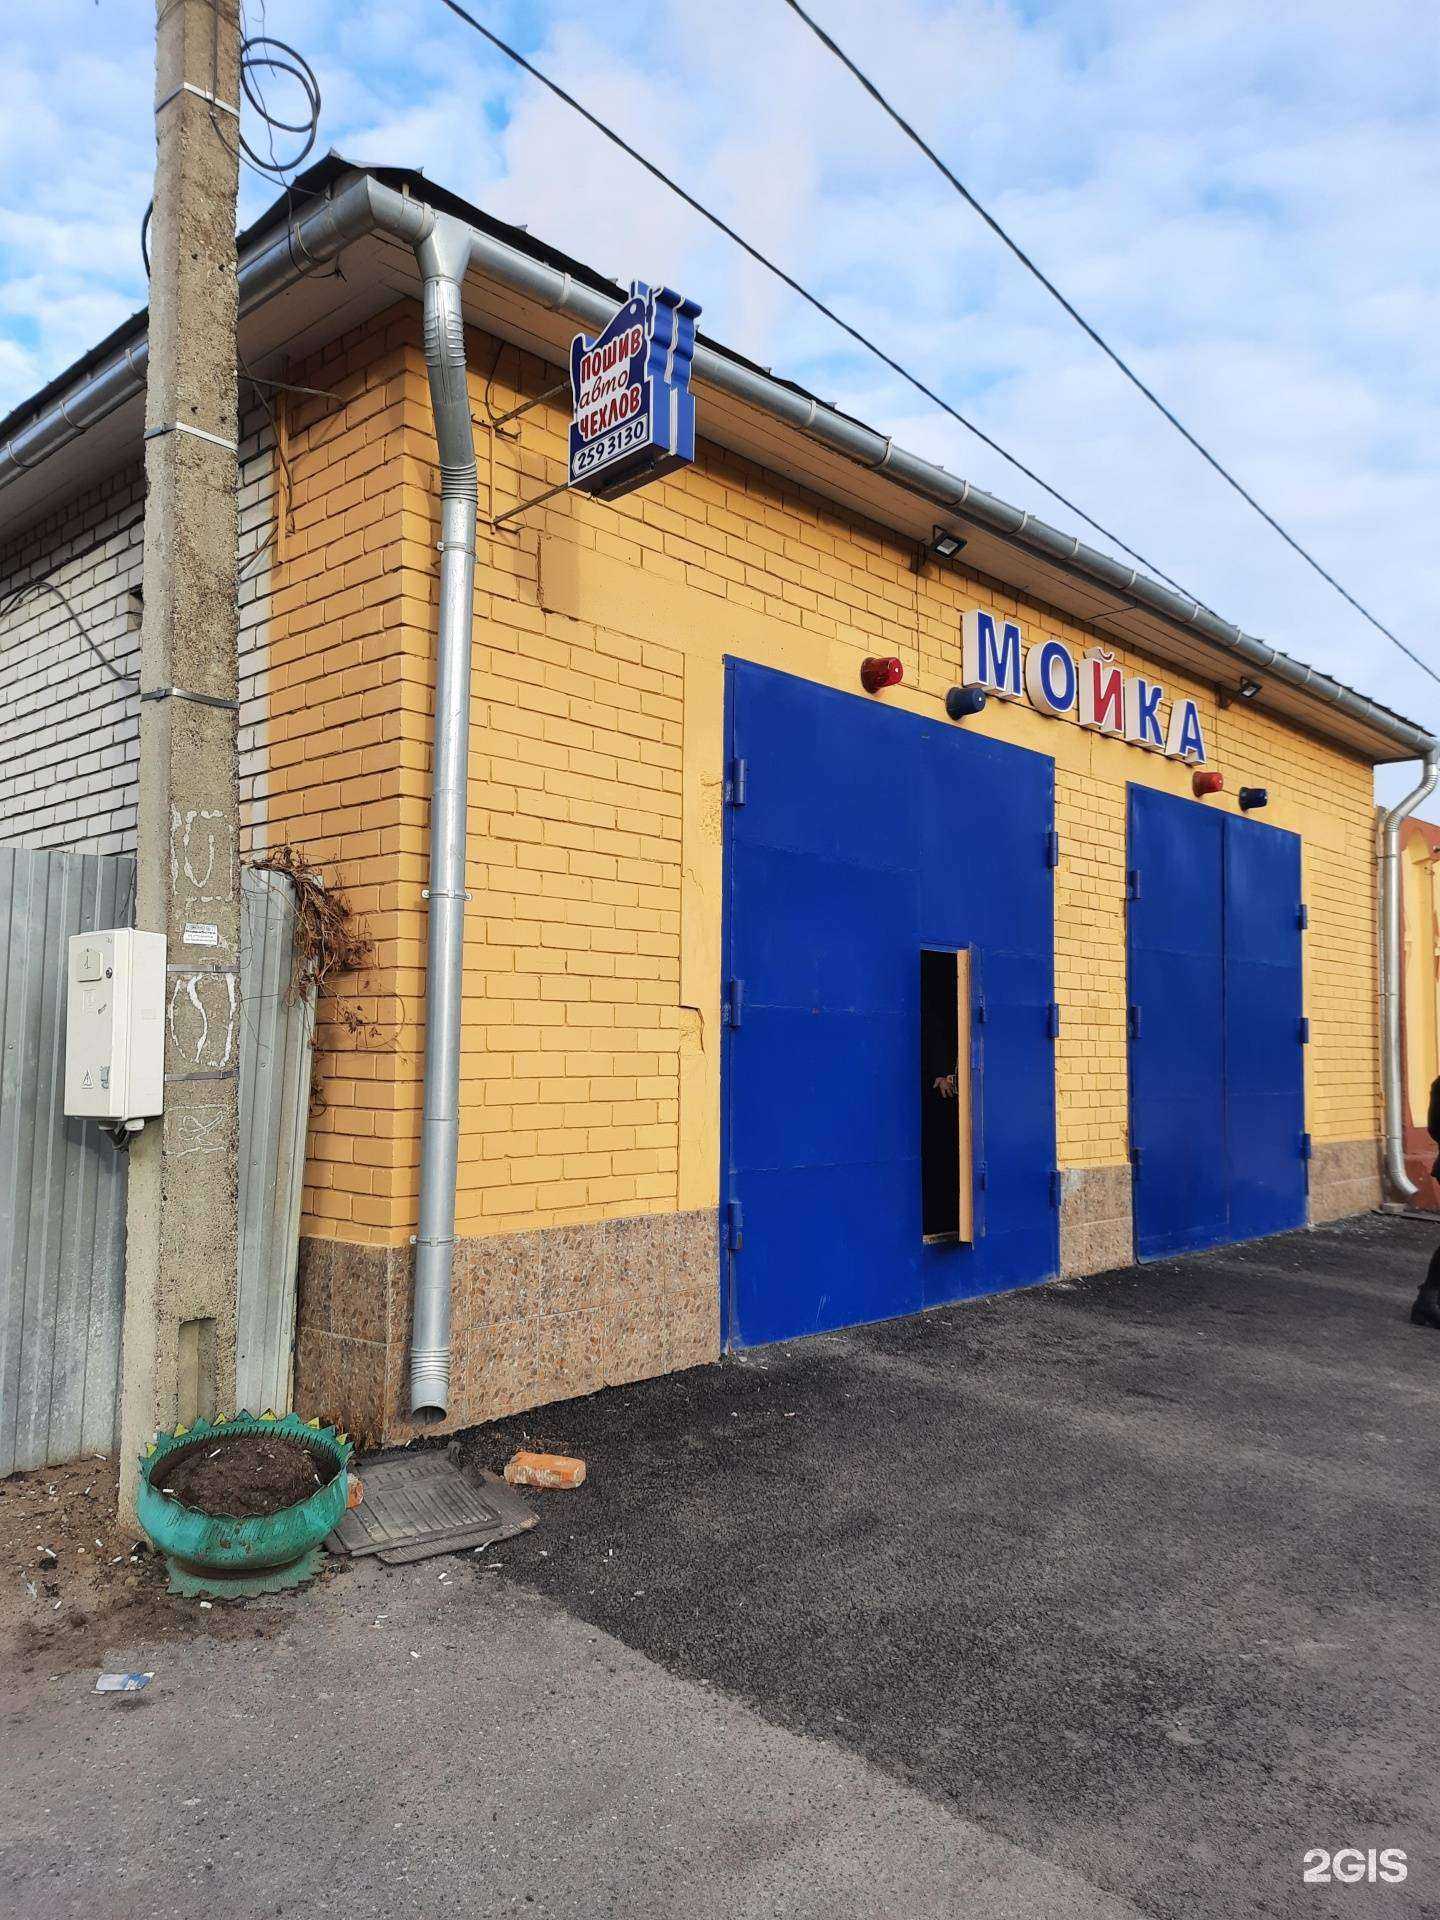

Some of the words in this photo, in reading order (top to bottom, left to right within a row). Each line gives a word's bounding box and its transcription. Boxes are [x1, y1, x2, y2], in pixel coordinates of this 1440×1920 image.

[581, 328, 642, 384] ПОШИВ
[579, 370, 628, 410] авто
[580, 386, 640, 440] ЧЕХЛОВ
[577, 421, 644, 470] 2593130
[963, 609, 1207, 767] МОЙКА
